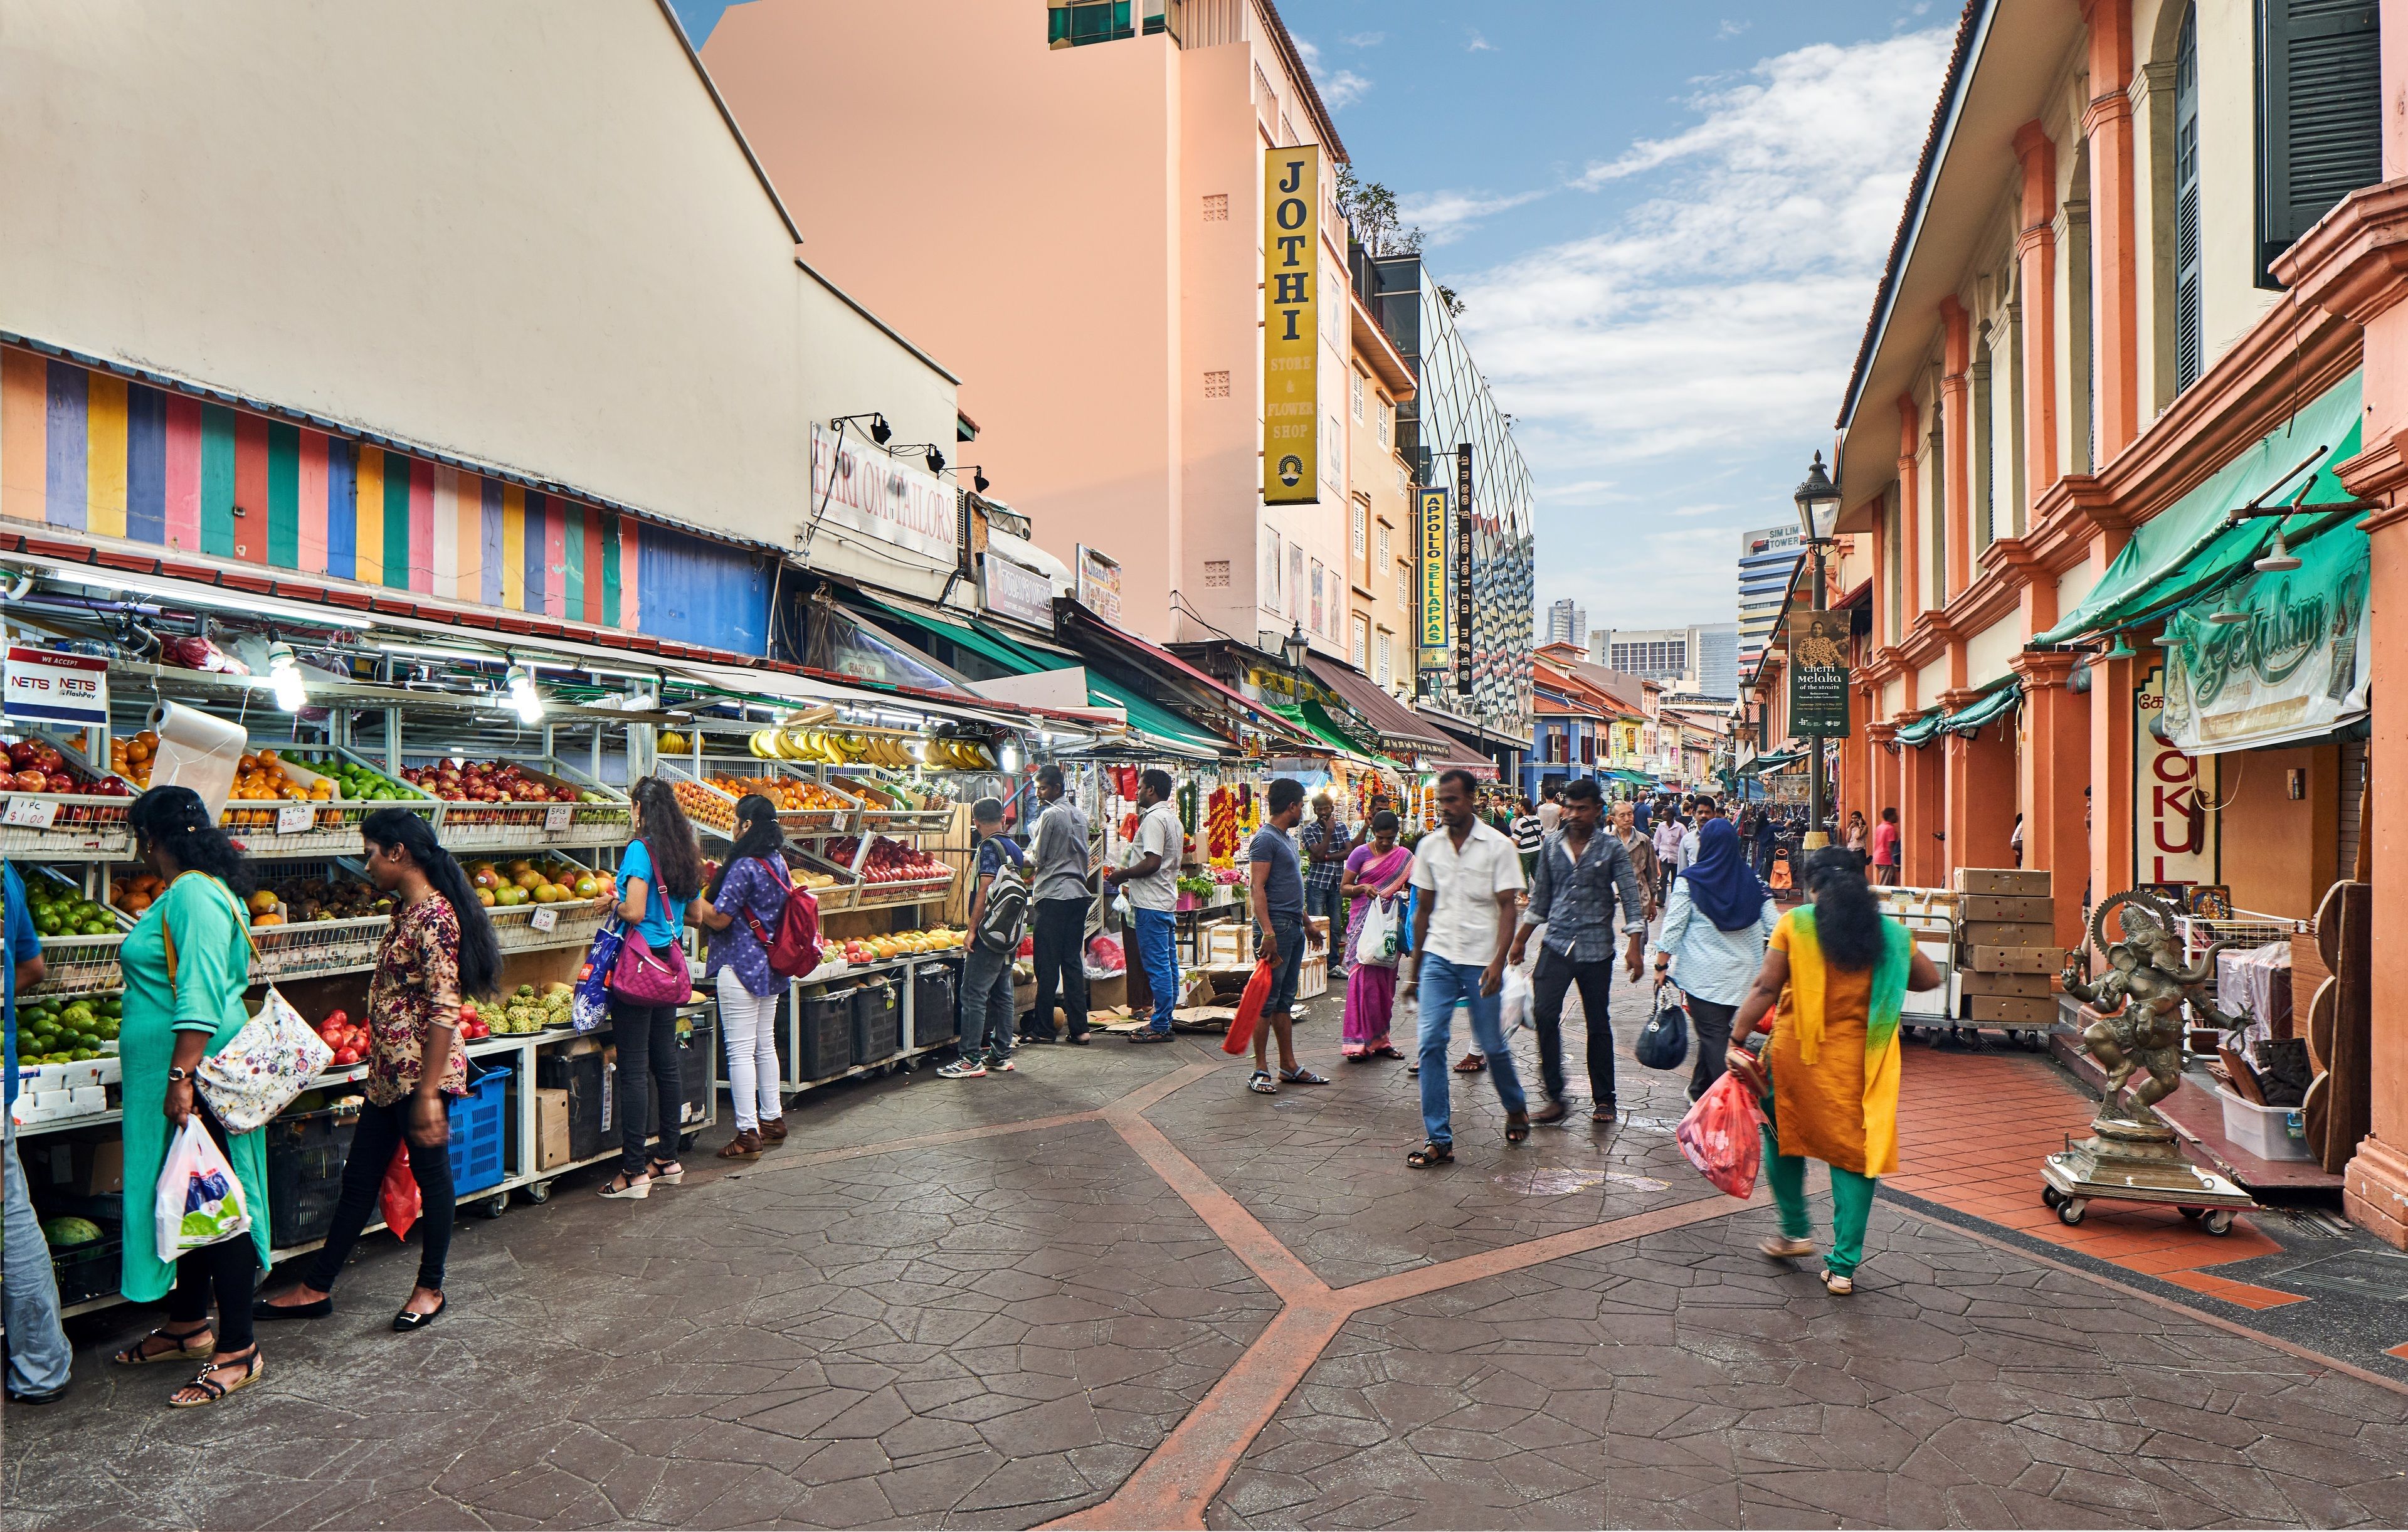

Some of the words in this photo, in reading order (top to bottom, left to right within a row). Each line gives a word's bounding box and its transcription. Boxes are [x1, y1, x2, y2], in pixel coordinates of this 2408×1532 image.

[1274, 161, 1309, 341] JOTHI
[1271, 356, 1311, 371] STORE
[1286, 380, 1294, 393] &
[1268, 402, 1313, 416] FLOWER
[1274, 425, 1307, 438] SHOP
[813, 440, 858, 509] HARI
[863, 461, 888, 520] OM
[894, 475, 953, 544] TAILORS
[1427, 497, 1441, 558] APPOLLO
[1770, 529, 1783, 538] SIM
[1785, 526, 1798, 536] LIM
[1770, 537, 1798, 548] TOWER
[1427, 563, 1441, 641] SELLAPPAS
[53, 658, 78, 666] ACCEPT
[849, 662, 865, 673] HARI
[867, 665, 876, 675] OM
[12, 676, 50, 690] NETS
[60, 677, 96, 691] NETS
[66, 690, 95, 699] FlashPay
[2153, 735, 2199, 885] OKUL
[9, 811, 44, 823] $1.00
[281, 816, 306, 826] $2.00
